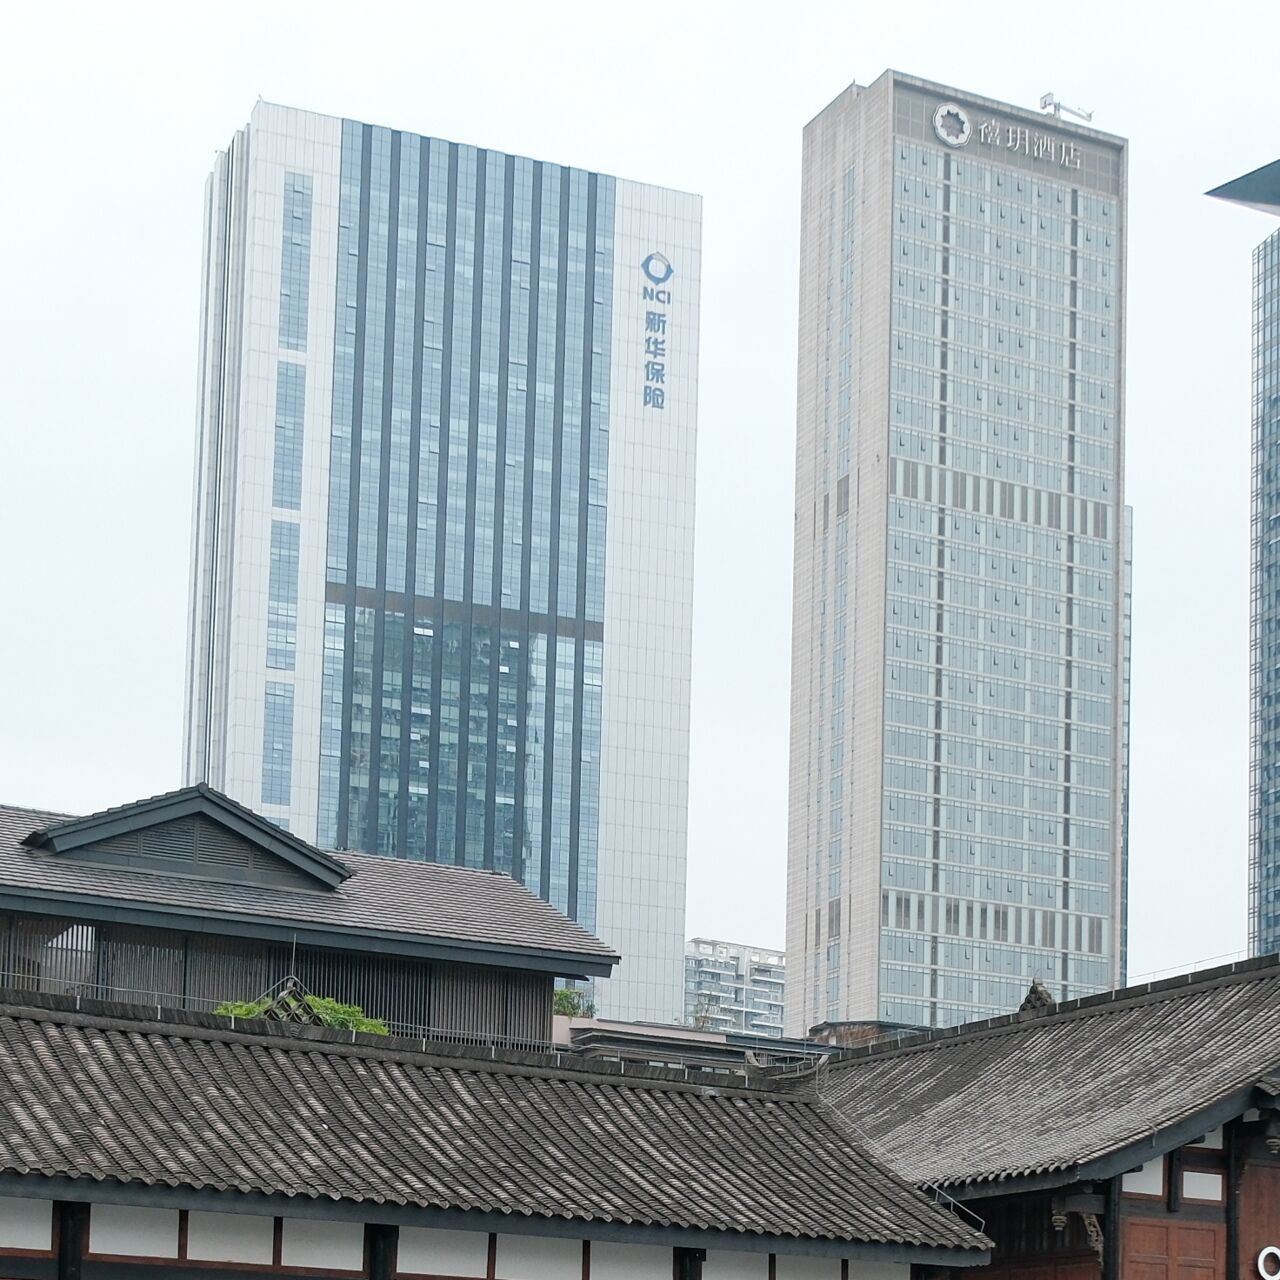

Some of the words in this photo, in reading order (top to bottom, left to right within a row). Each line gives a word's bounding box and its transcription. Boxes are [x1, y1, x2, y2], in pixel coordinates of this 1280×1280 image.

[642, 287, 671, 304] NCI
[643, 311, 667, 409] 新华保险
